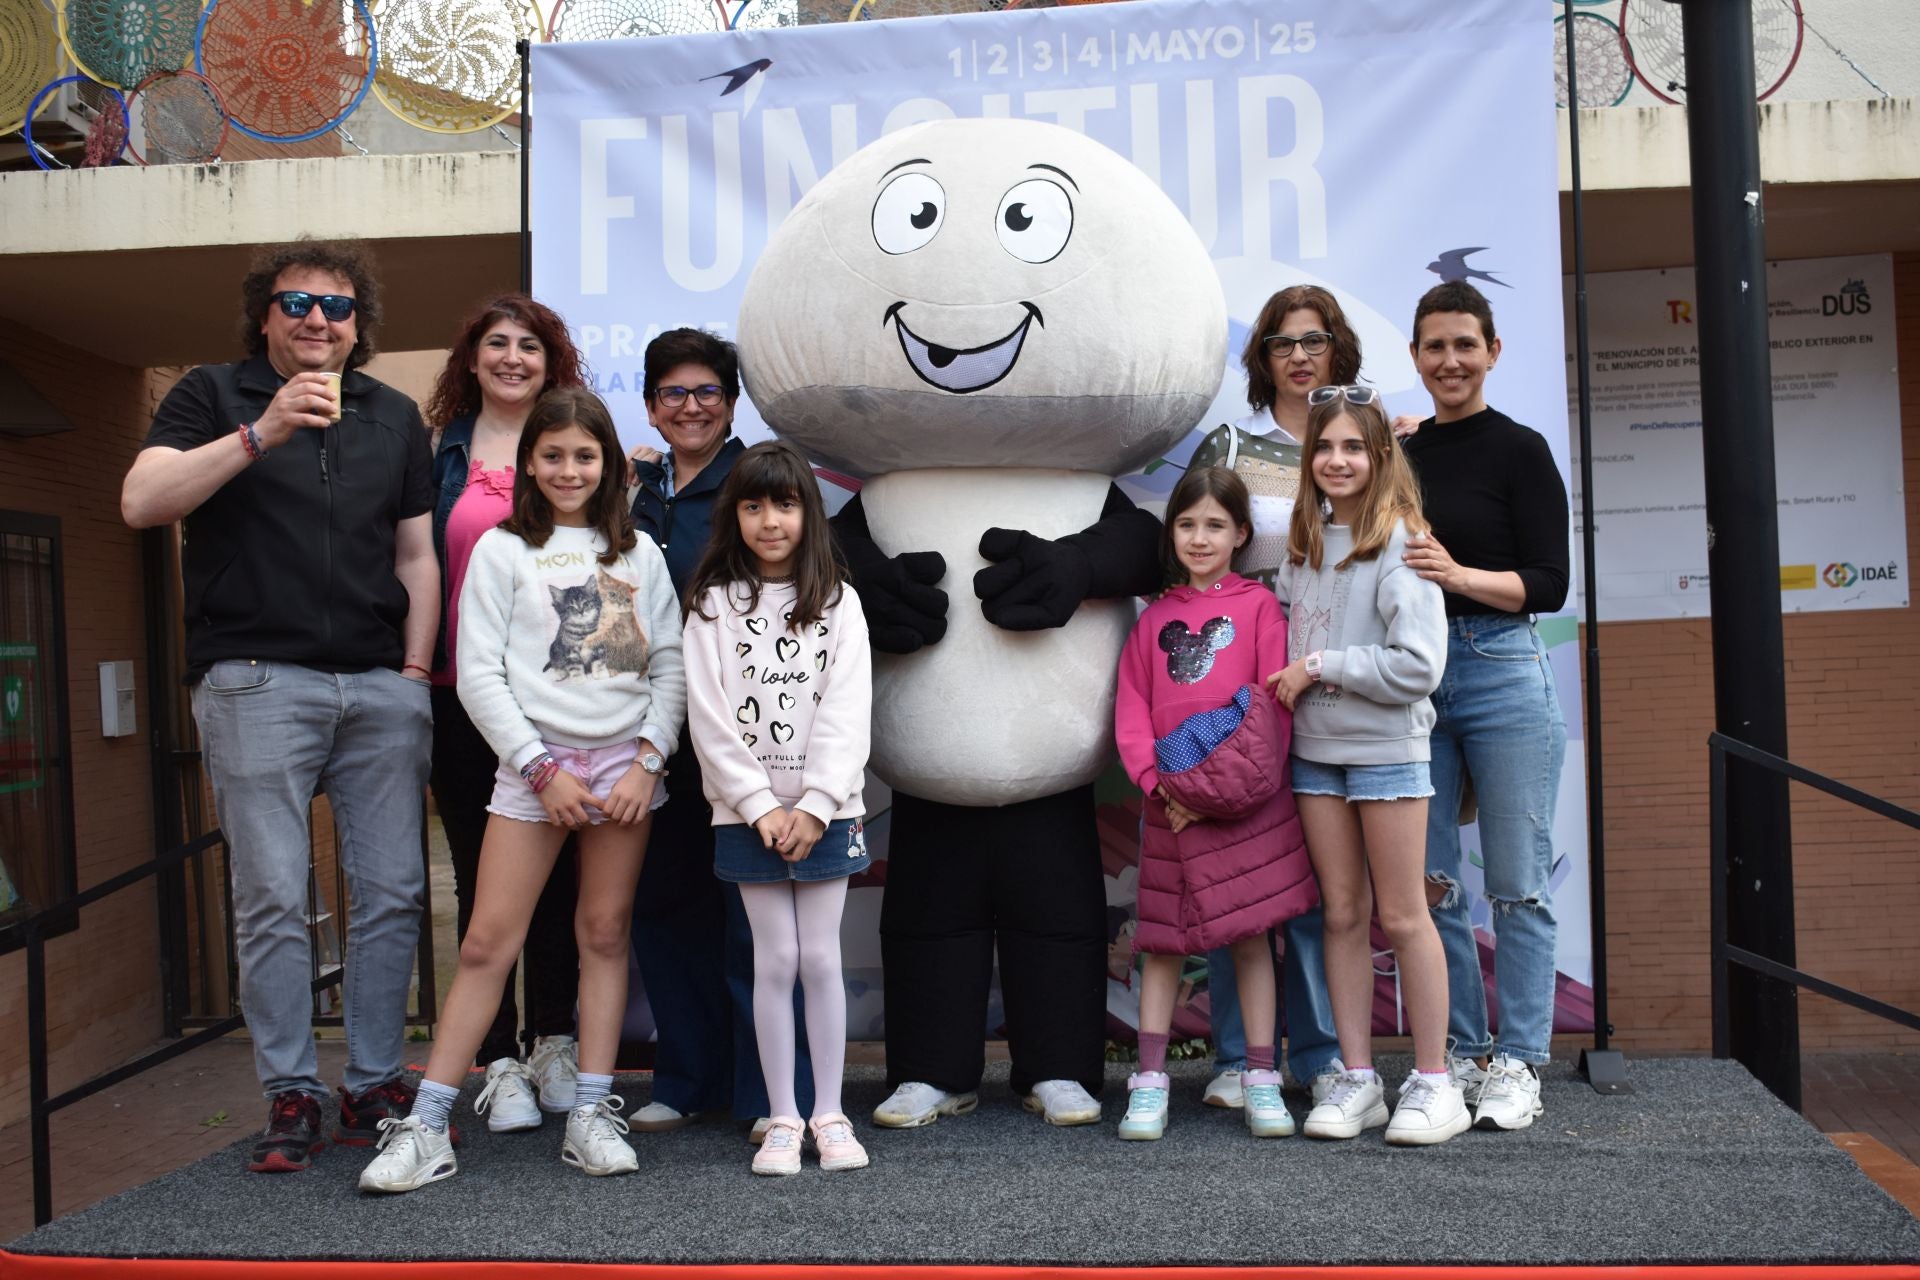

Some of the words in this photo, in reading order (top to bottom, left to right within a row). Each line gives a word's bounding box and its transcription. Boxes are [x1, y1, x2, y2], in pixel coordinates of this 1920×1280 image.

[1127, 26, 1245, 64] MAYO
[1270, 22, 1316, 54] 25
[1822, 293, 1872, 316] DUS
[1805, 336, 1857, 347] EXTERIOR
[1859, 335, 1874, 344] EN
[1668, 346, 1687, 356] DEL
[1596, 363, 1609, 372] EL
[1611, 360, 1664, 371] MUNICIPIO
[1666, 359, 1681, 368] DE
[761, 667, 810, 685] love
